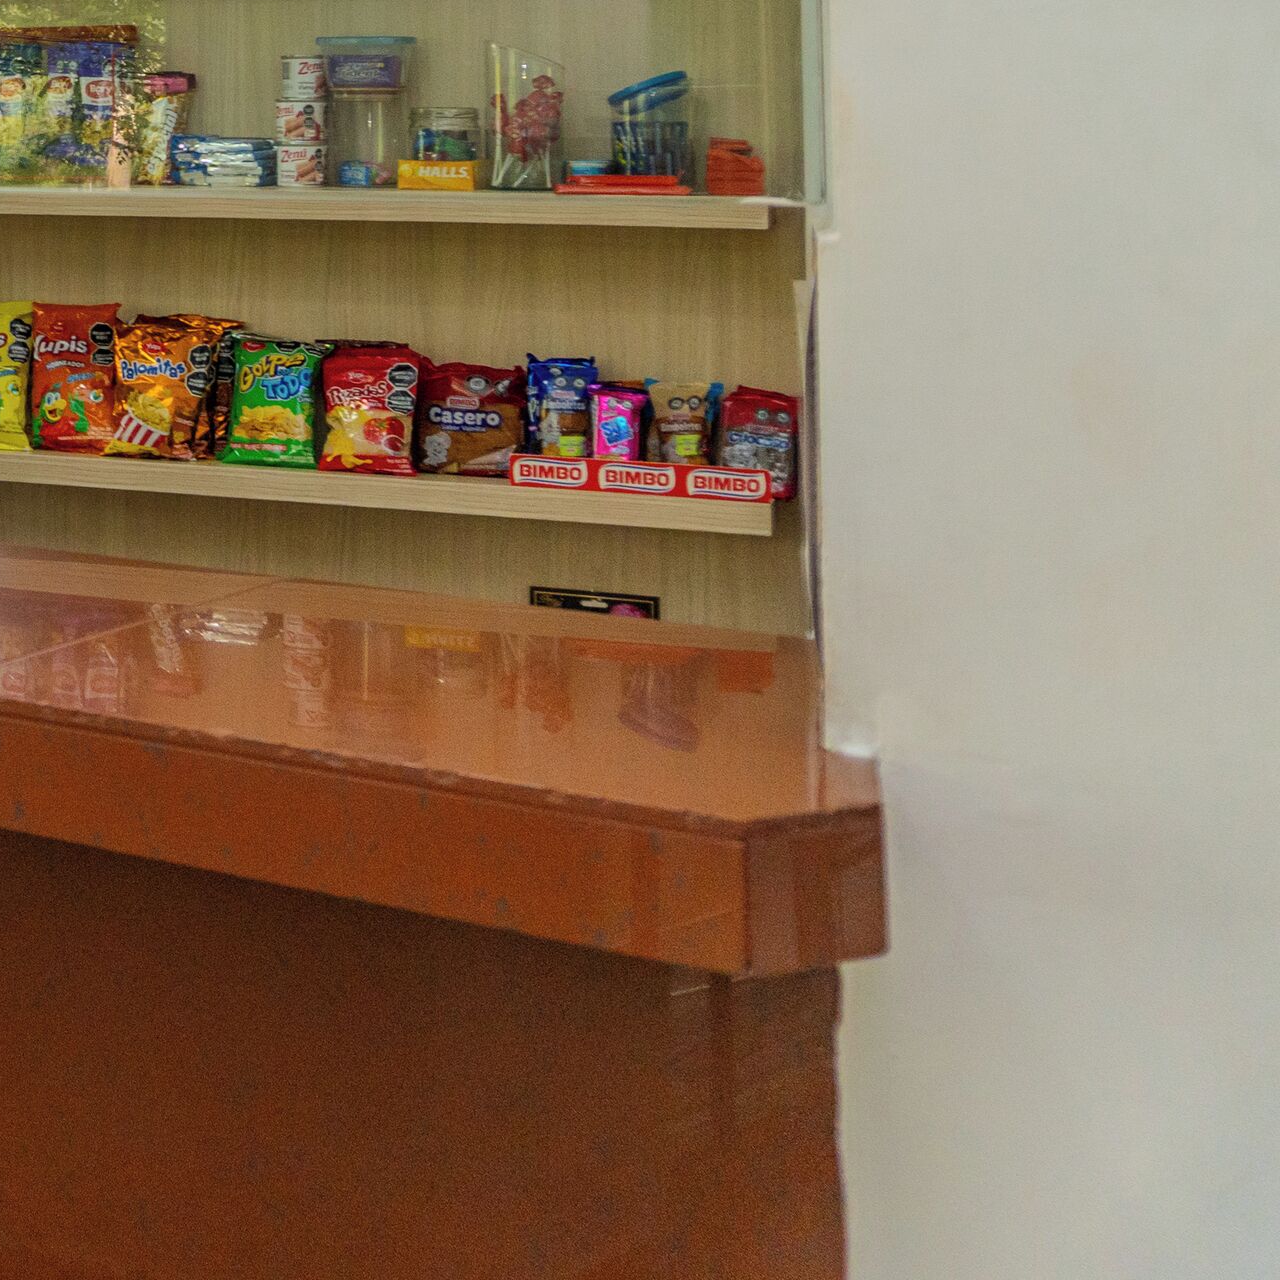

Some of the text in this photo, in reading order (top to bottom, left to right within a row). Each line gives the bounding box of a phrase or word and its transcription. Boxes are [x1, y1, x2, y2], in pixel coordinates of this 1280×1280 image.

[417, 166, 468, 178] HALLS
[120, 357, 186, 380] Palomitas
[429, 406, 501, 426] Casero
[519, 464, 760, 493] BIMBO BIMBO BIMBO
